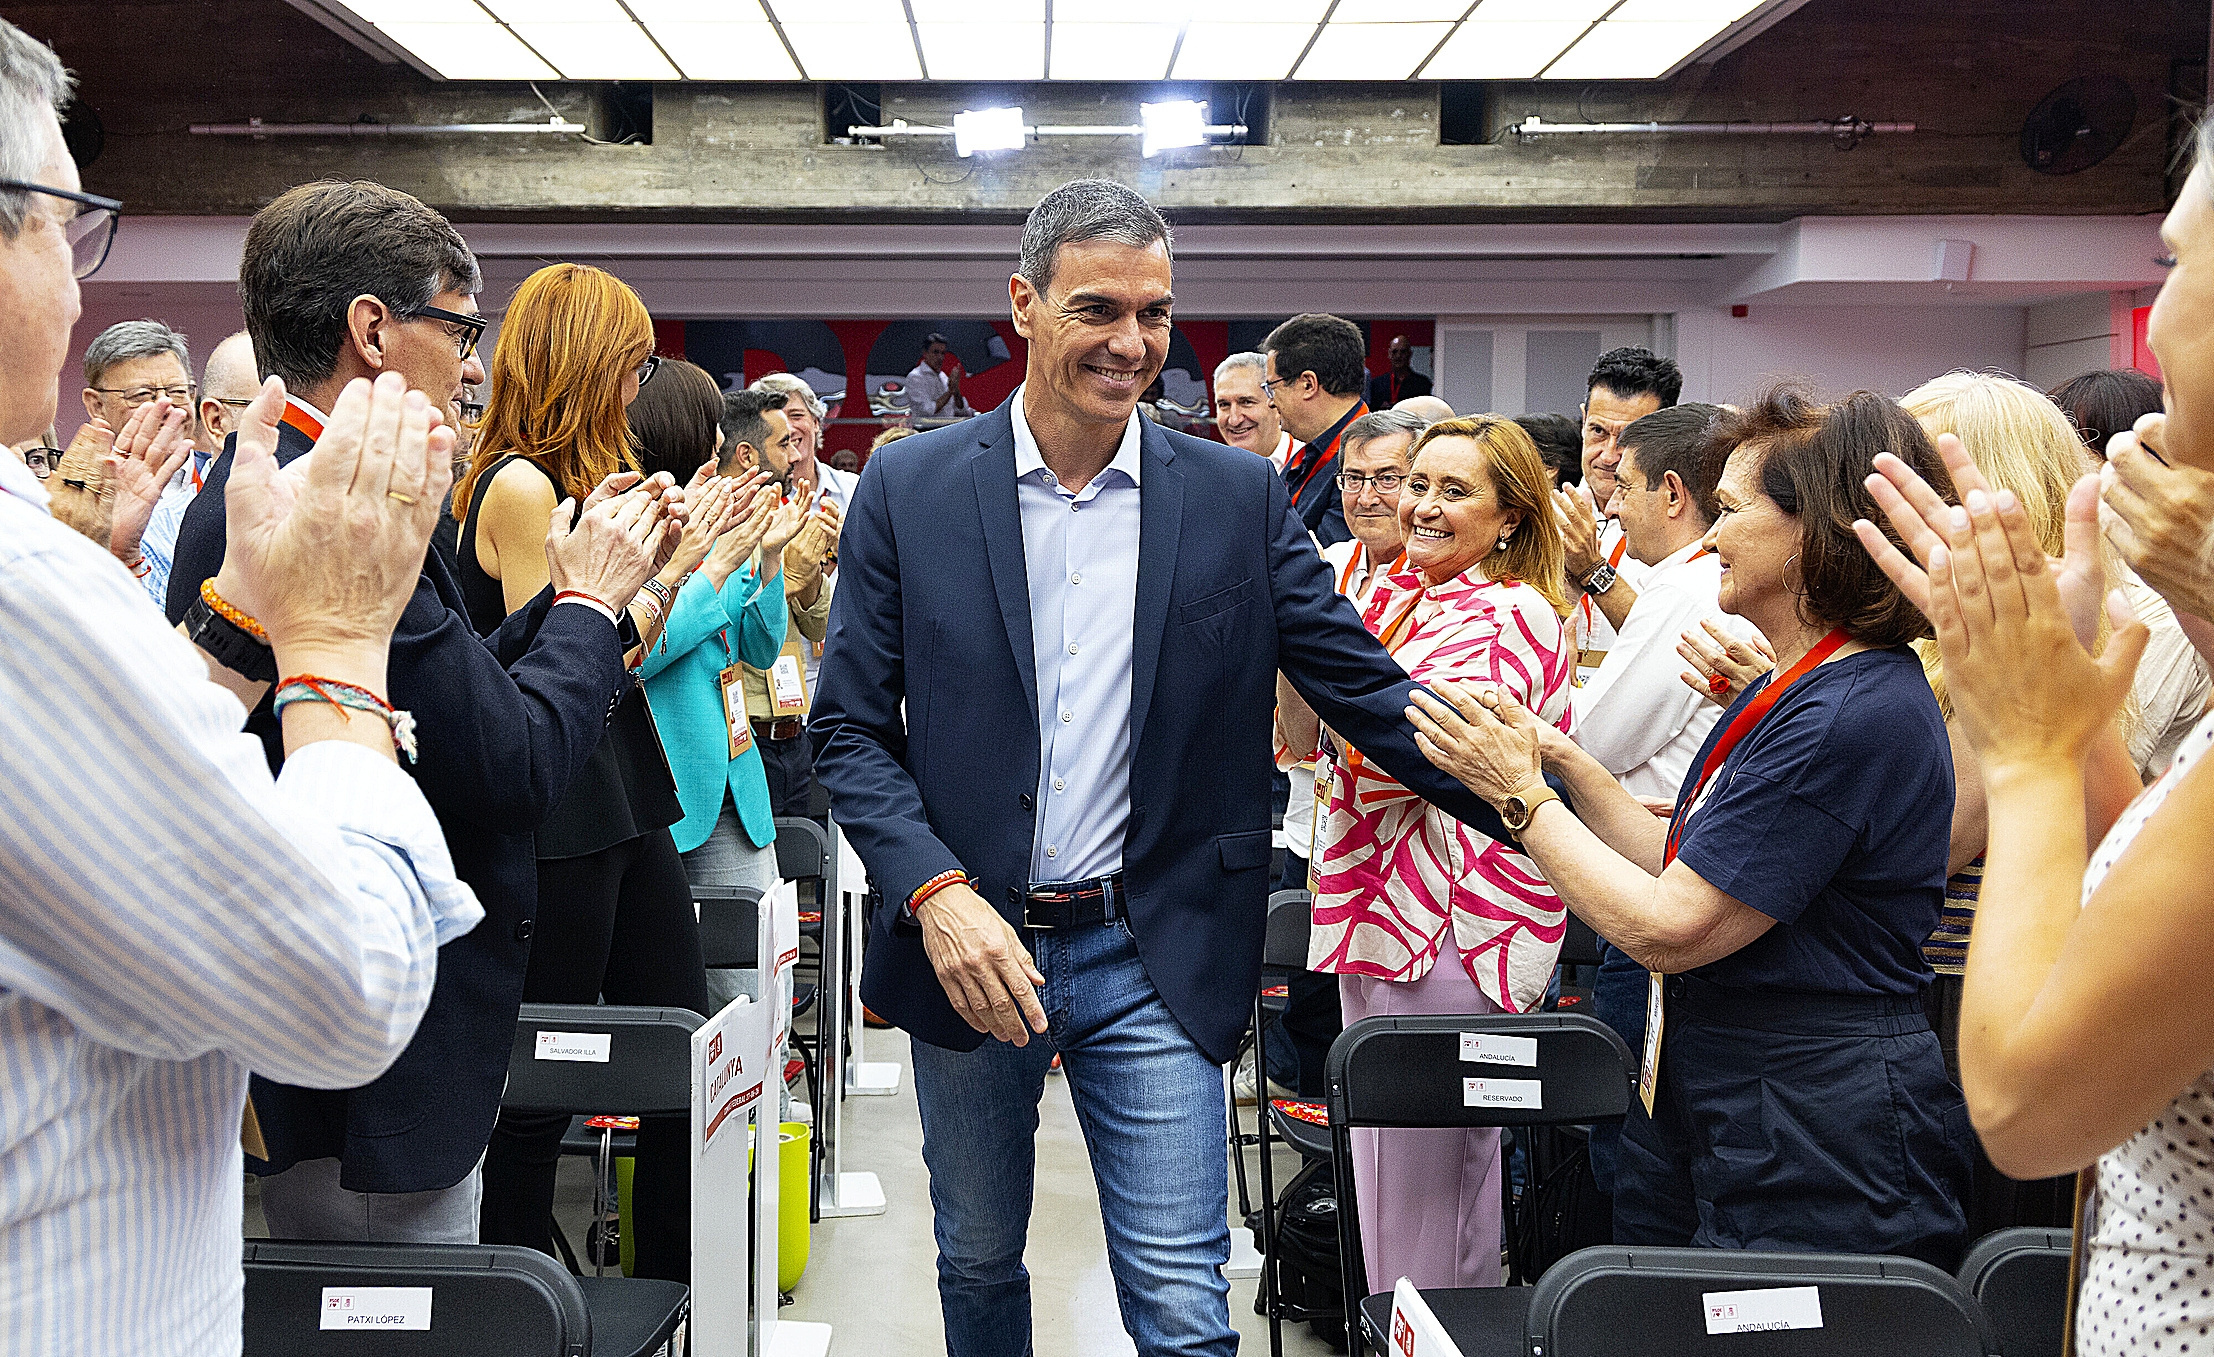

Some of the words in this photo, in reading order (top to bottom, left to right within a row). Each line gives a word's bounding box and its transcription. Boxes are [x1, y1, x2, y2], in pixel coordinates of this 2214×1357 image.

[549, 1047, 582, 1055] SALVADOR
[583, 1048, 597, 1056] ILLA
[1479, 1053, 1516, 1062] ANDALUCÍA
[709, 1055, 744, 1104] CATALUNYA
[1482, 1094, 1523, 1102] RESERVADO
[347, 1315, 374, 1324] PATXI
[376, 1314, 405, 1324] LÓPEZ
[1736, 1319, 1791, 1332] ANDALUCÍA
